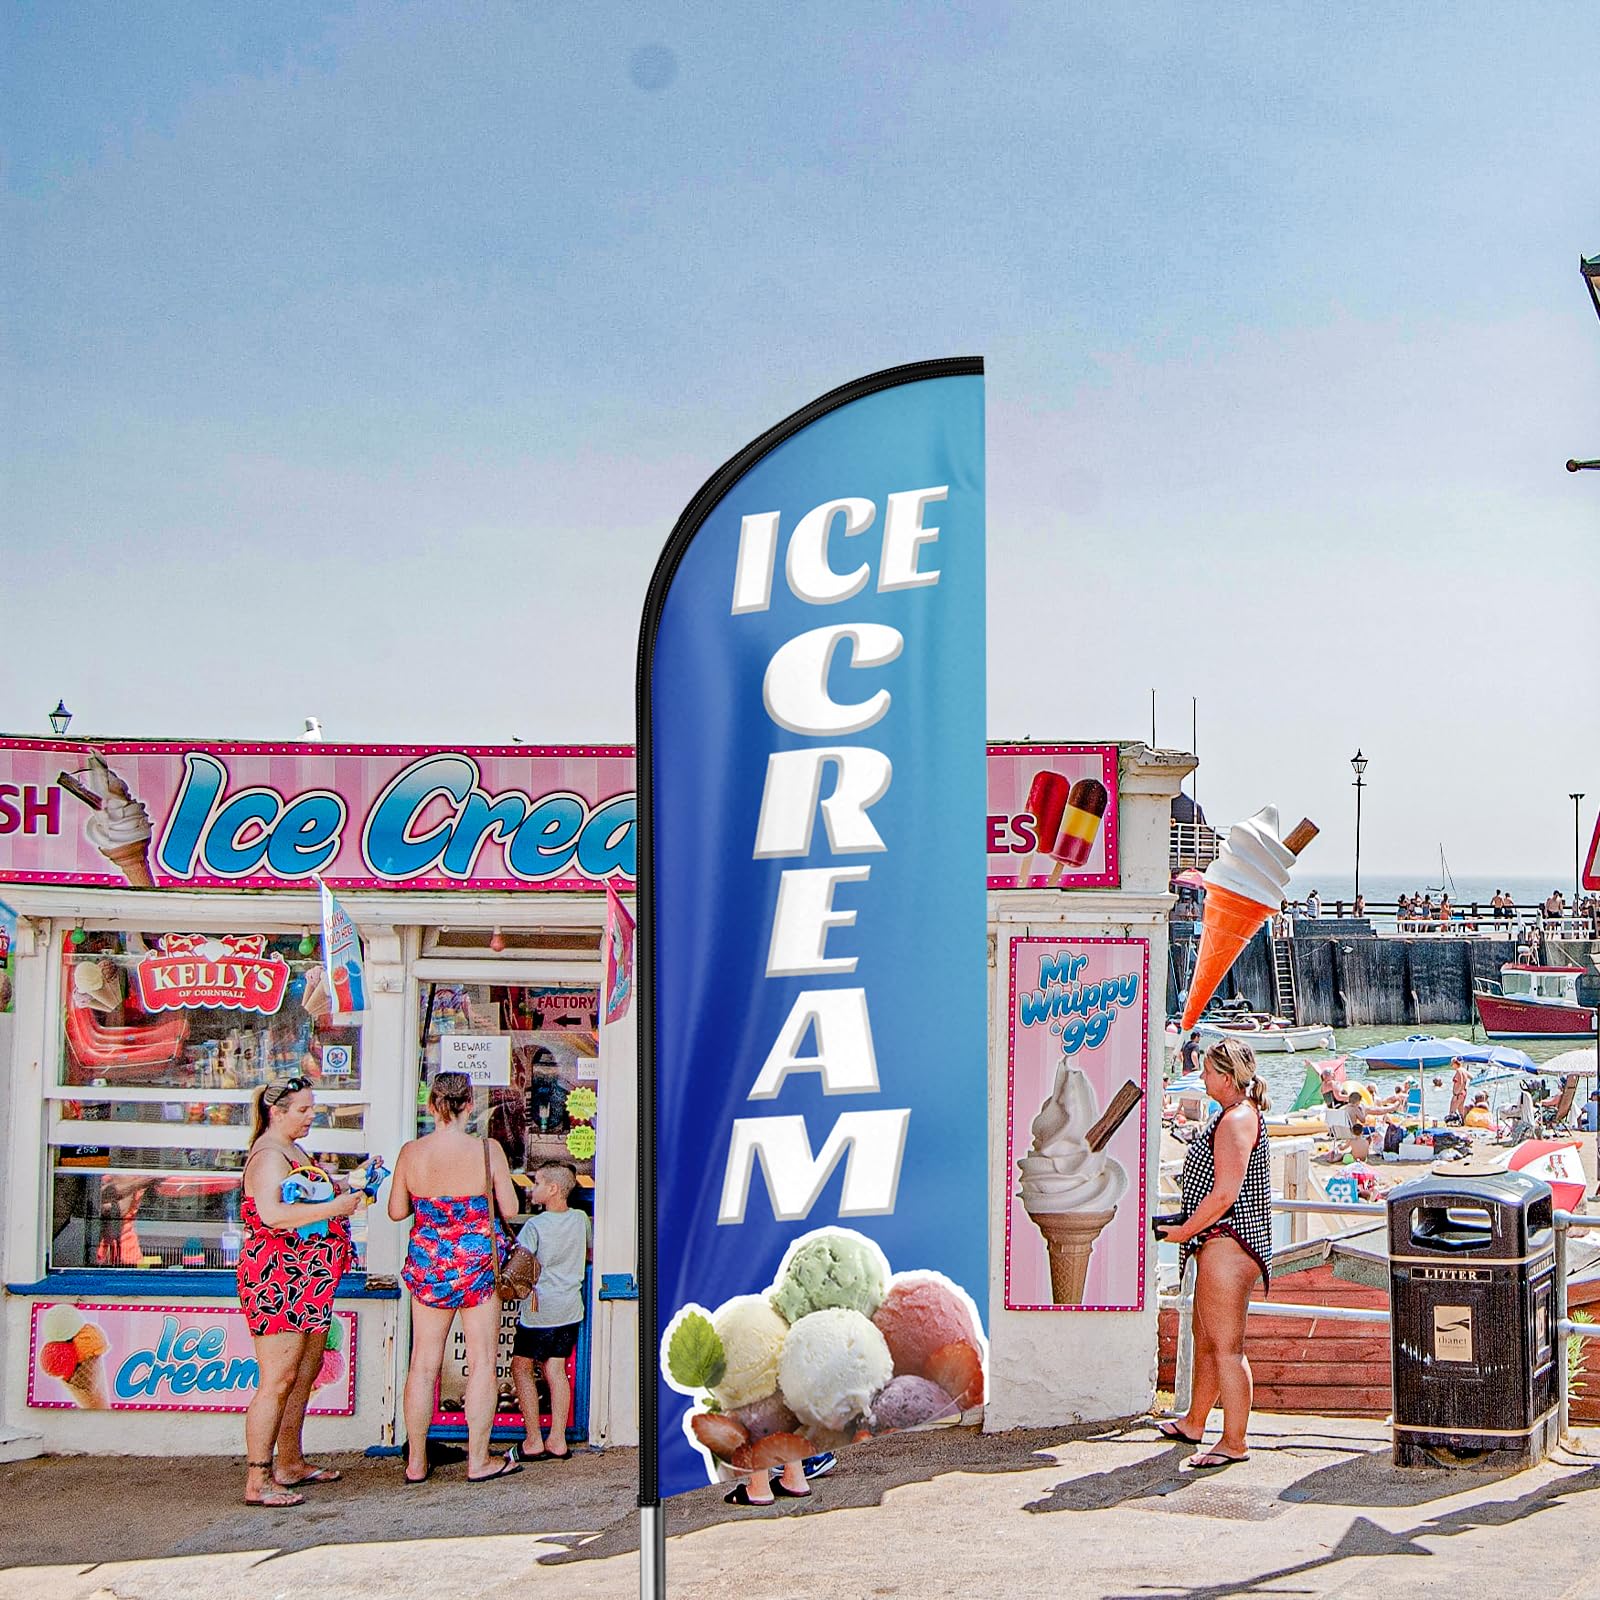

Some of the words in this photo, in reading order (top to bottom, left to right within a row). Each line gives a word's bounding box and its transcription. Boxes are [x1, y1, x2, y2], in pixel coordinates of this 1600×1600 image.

[731, 485, 949, 616] ICE
[158, 752, 346, 880] Ice
[362, 752, 637, 882] Crea
[986, 814, 1038, 854] ES
[717, 623, 912, 1226] CREAM
[151, 962, 275, 993] KELLY'S
[1040, 950, 1088, 990] Mr
[178, 990, 190, 998] OF
[194, 989, 245, 999] CORNWALL
[538, 996, 596, 1009] FACTORY
[1020, 972, 1139, 1028] Whippy
[453, 1042, 493, 1052] BEWARE
[1424, 1269, 1478, 1280] LITTER
[156, 1314, 227, 1362] Ice
[114, 1349, 260, 1399] Cream
